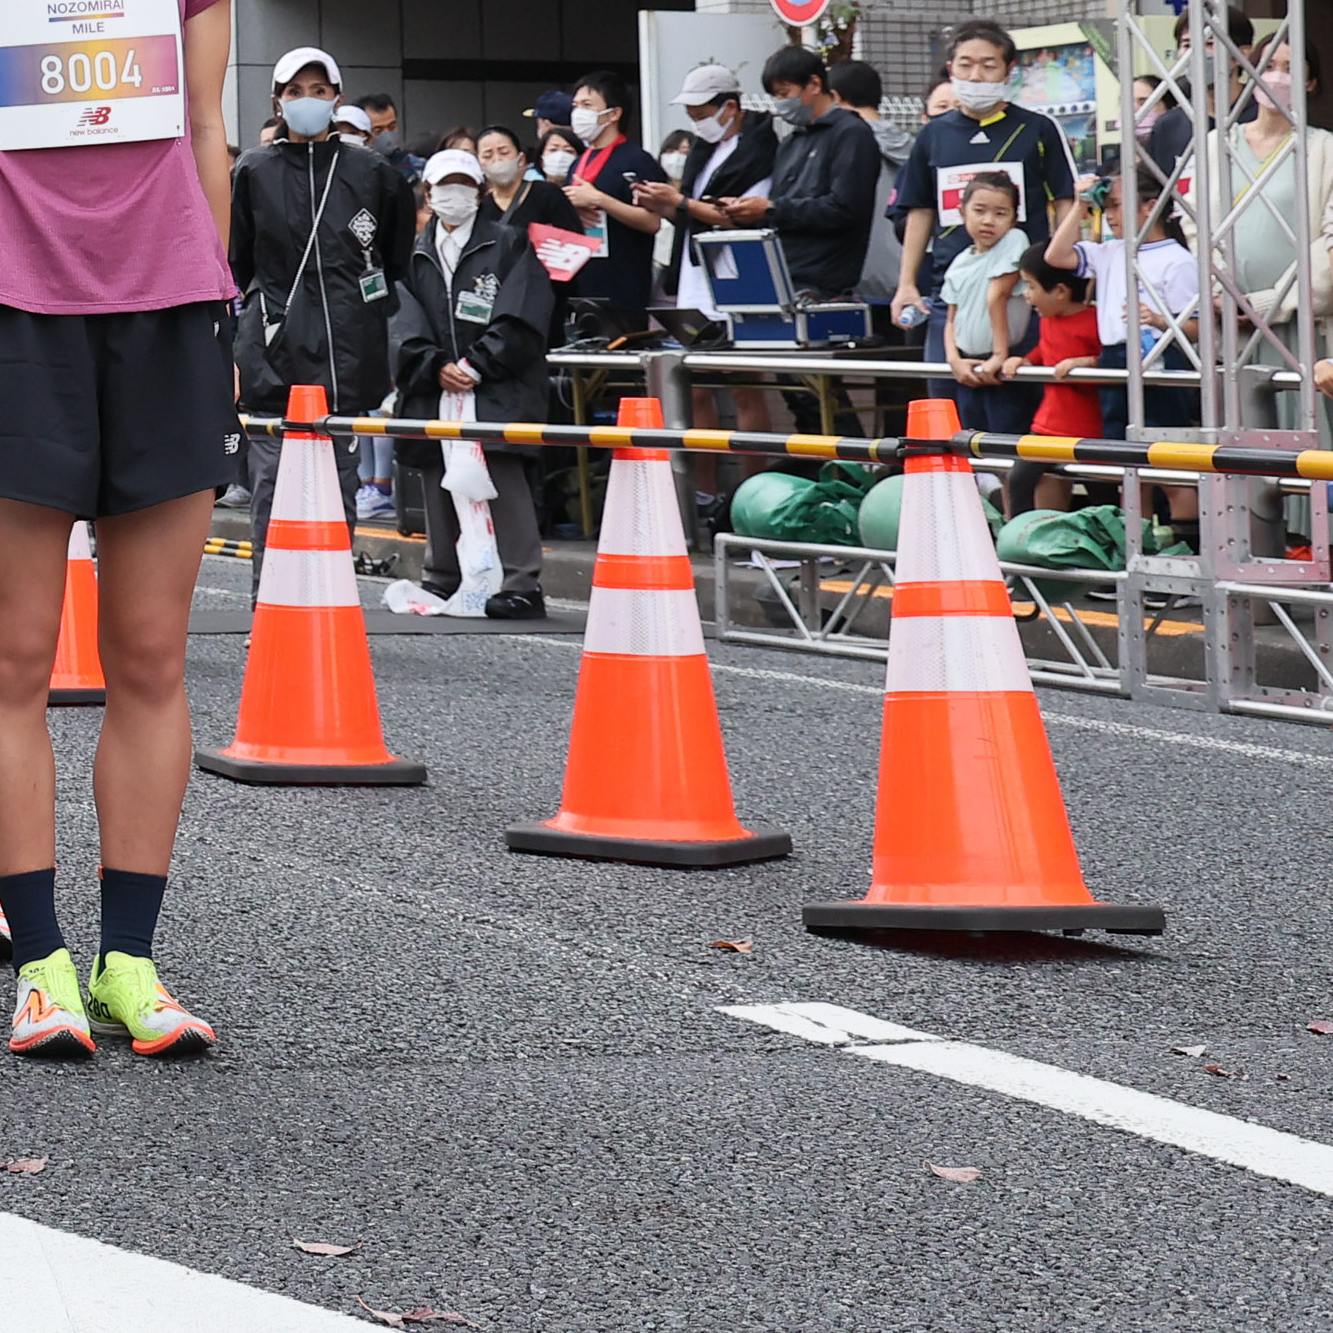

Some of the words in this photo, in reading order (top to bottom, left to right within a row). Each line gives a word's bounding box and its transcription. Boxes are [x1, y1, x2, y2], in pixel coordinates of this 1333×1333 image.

[72, 21, 106, 34] MILE
[40, 49, 143, 95] 8004
[87, 127, 119, 135] balance
